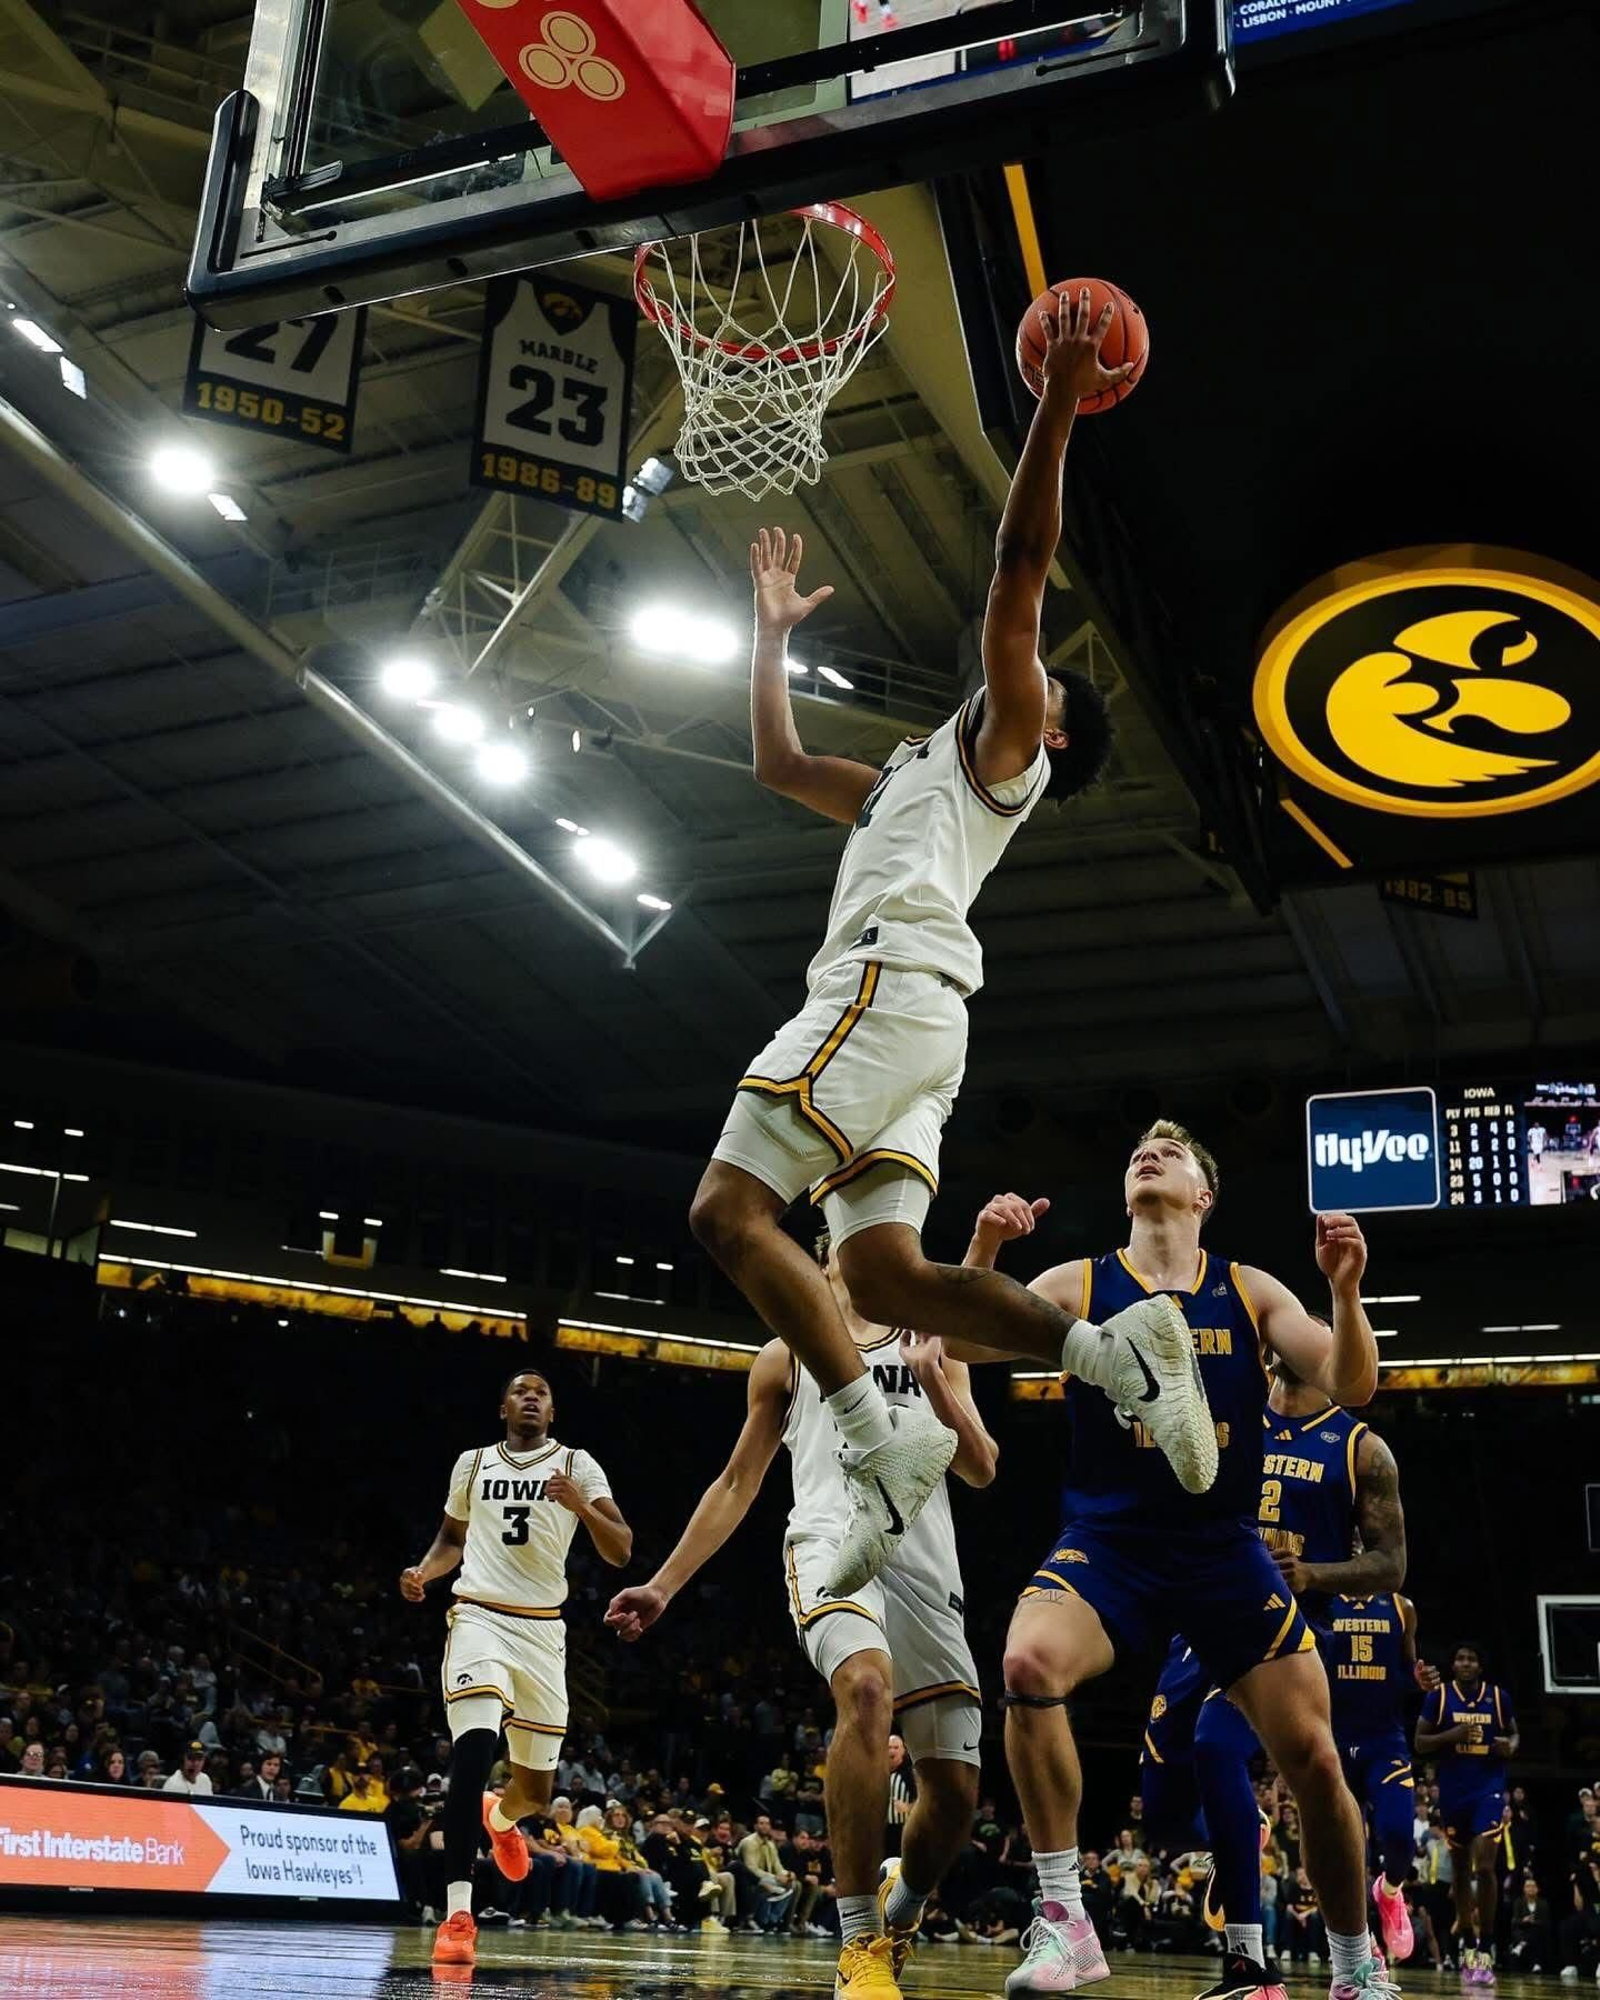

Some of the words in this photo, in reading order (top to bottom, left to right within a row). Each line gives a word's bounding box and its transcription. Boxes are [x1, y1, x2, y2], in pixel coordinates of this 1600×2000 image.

[1243, 9, 1287, 28] LISBON
[520, 339, 598, 374] MARBLE
[198, 382, 346, 441] 1950-52
[505, 364, 608, 447] 23
[482, 453, 616, 509] 1986-89
[1464, 1087, 1496, 1099] IOWA
[1470, 1122, 1478, 1136] 2
[1508, 1136, 1516, 1150] 0
[1493, 1154, 1500, 1169] 1
[1509, 1154, 1517, 1168] 1
[1509, 1171, 1518, 1185] 0
[1494, 1189, 1502, 1203] 1
[1510, 1188, 1519, 1202] 0
[1262, 1454, 1324, 1482] STERN
[1259, 1480, 1281, 1522] 2
[502, 1506, 531, 1546] 3
[1351, 1635, 1373, 1662] 15
[44, 1830, 144, 1863] Interstate
[145, 1837, 185, 1865] Bank
[240, 1824, 282, 1849] Proud
[286, 1832, 338, 1856] sponsor
[341, 1832, 354, 1854] of
[356, 1834, 377, 1856] the
[246, 1857, 281, 1881] Iowa
